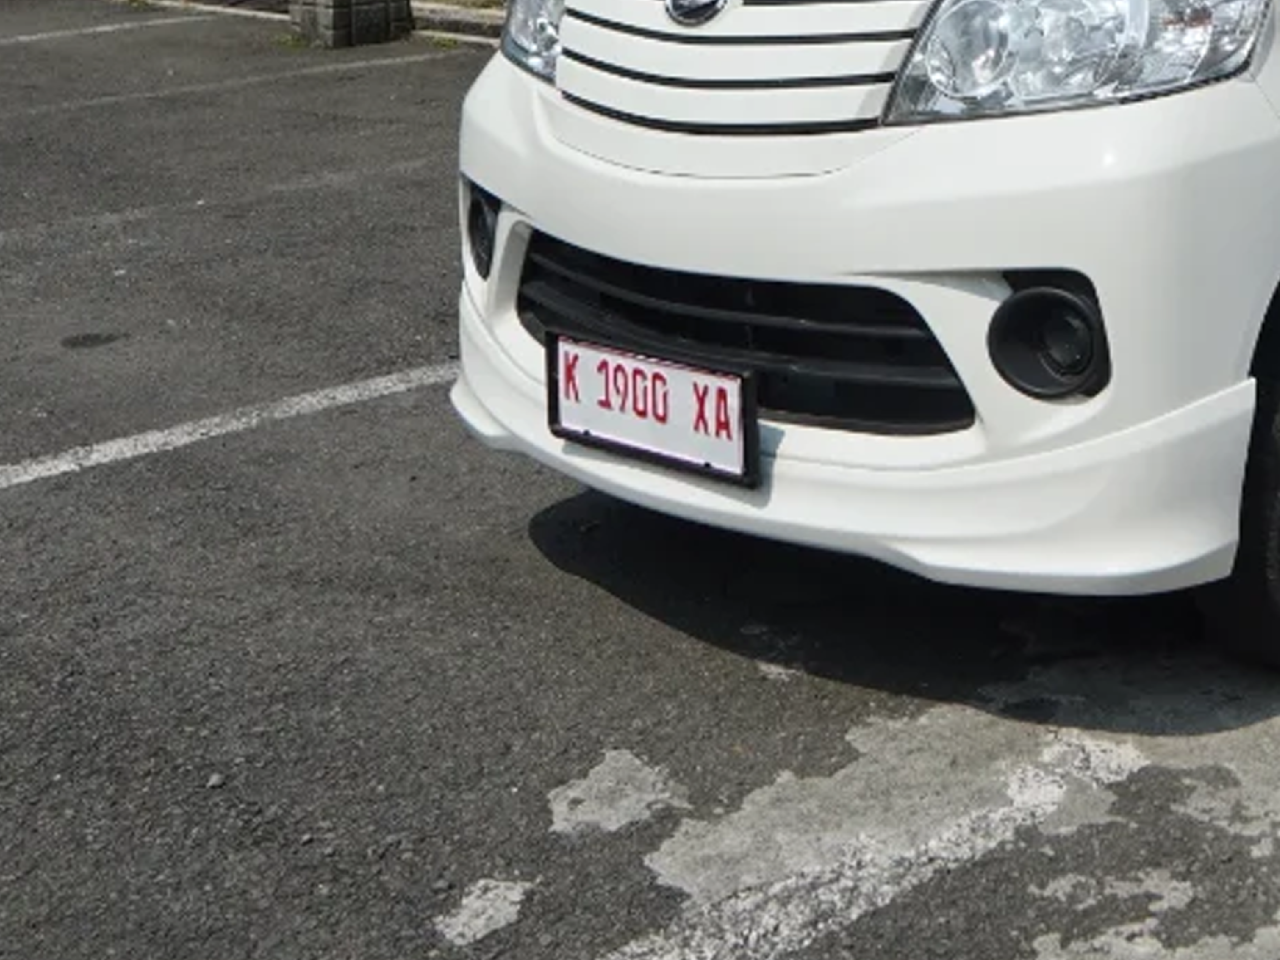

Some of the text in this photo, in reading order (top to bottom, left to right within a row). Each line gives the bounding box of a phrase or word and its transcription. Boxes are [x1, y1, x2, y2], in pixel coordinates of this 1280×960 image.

[564, 350, 732, 441] K 1900 XA
